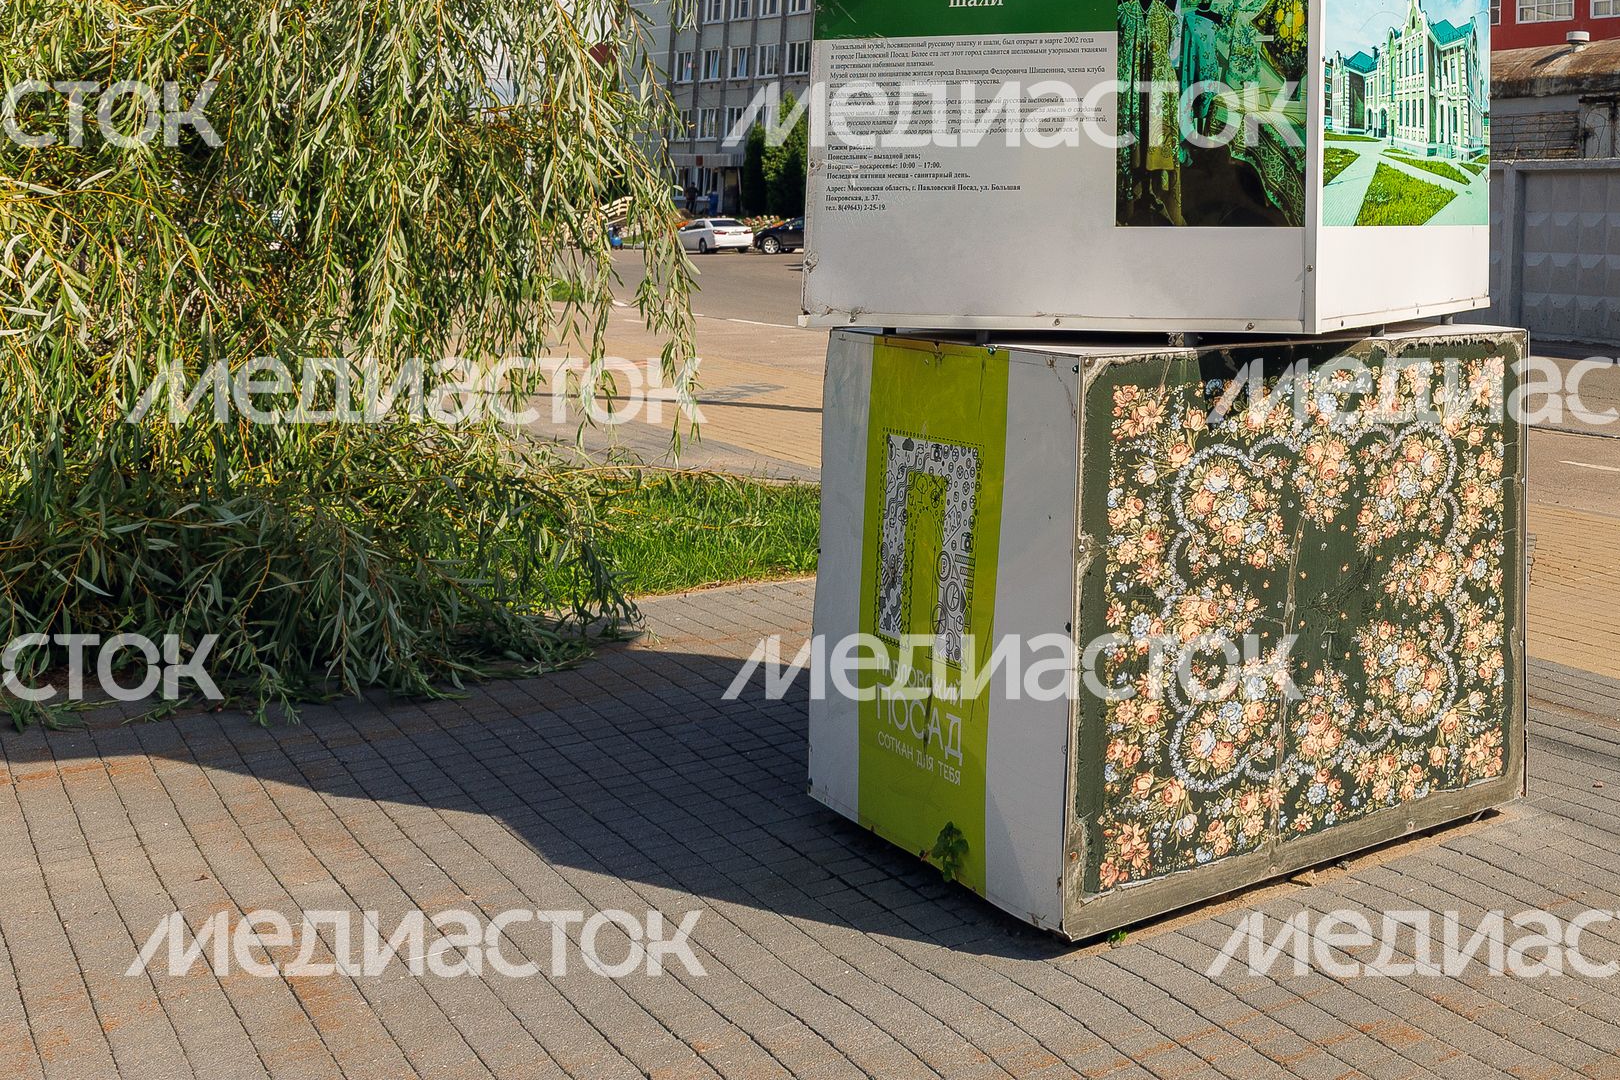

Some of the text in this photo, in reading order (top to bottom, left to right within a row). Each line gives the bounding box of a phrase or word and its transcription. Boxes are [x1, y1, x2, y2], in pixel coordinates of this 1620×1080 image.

[832, 42, 866, 50] Уникальный
[867, 42, 885, 50] музей,
[887, 41, 926, 50] посвященный
[928, 41, 956, 49] русскому
[856, 51, 889, 59] Павловский
[1048, 48, 1079, 56] узорными
[830, 71, 848, 80] Музей
[956, 68, 989, 77] Владимира
[1087, 66, 1105, 74] клуба
[914, 171, 952, 180] санитарный
[826, 185, 846, 193] Адрес:
[885, 184, 910, 192] область,
[826, 194, 863, 202] Покровская,
[876, 682, 963, 766] ПОСАД
[878, 731, 960, 786] СОТКАН ДЛЯ ТЕБЯ
